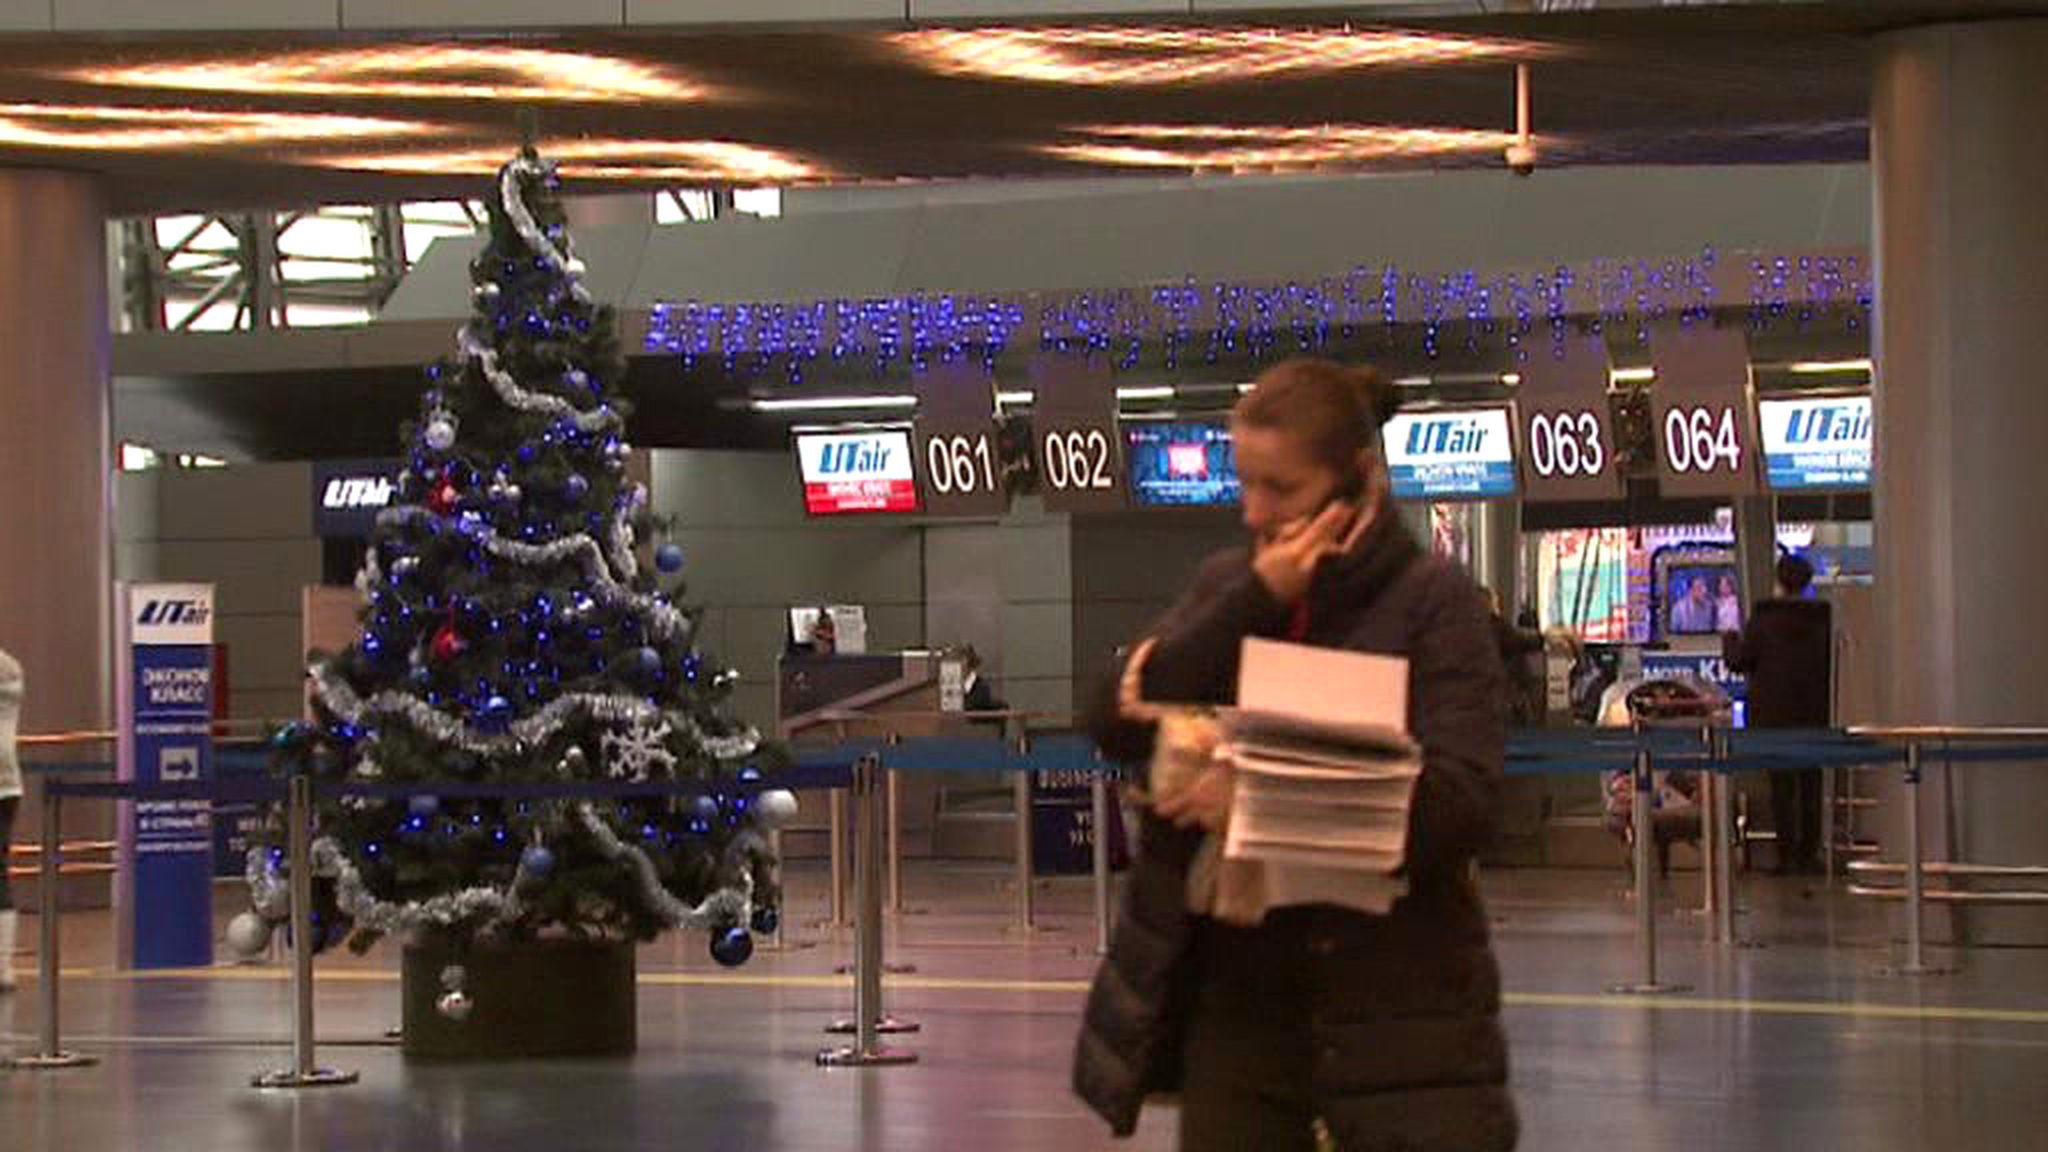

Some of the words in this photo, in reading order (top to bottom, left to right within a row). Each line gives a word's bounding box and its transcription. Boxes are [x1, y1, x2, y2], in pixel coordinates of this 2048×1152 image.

[819, 440, 891, 474] UTair
[929, 434, 993, 493] 061
[1046, 430, 1112, 488] 062
[1405, 419, 1488, 456] UTair
[1531, 412, 1602, 475] 063
[1666, 408, 1740, 471] 064
[138, 599, 209, 625] UTair
